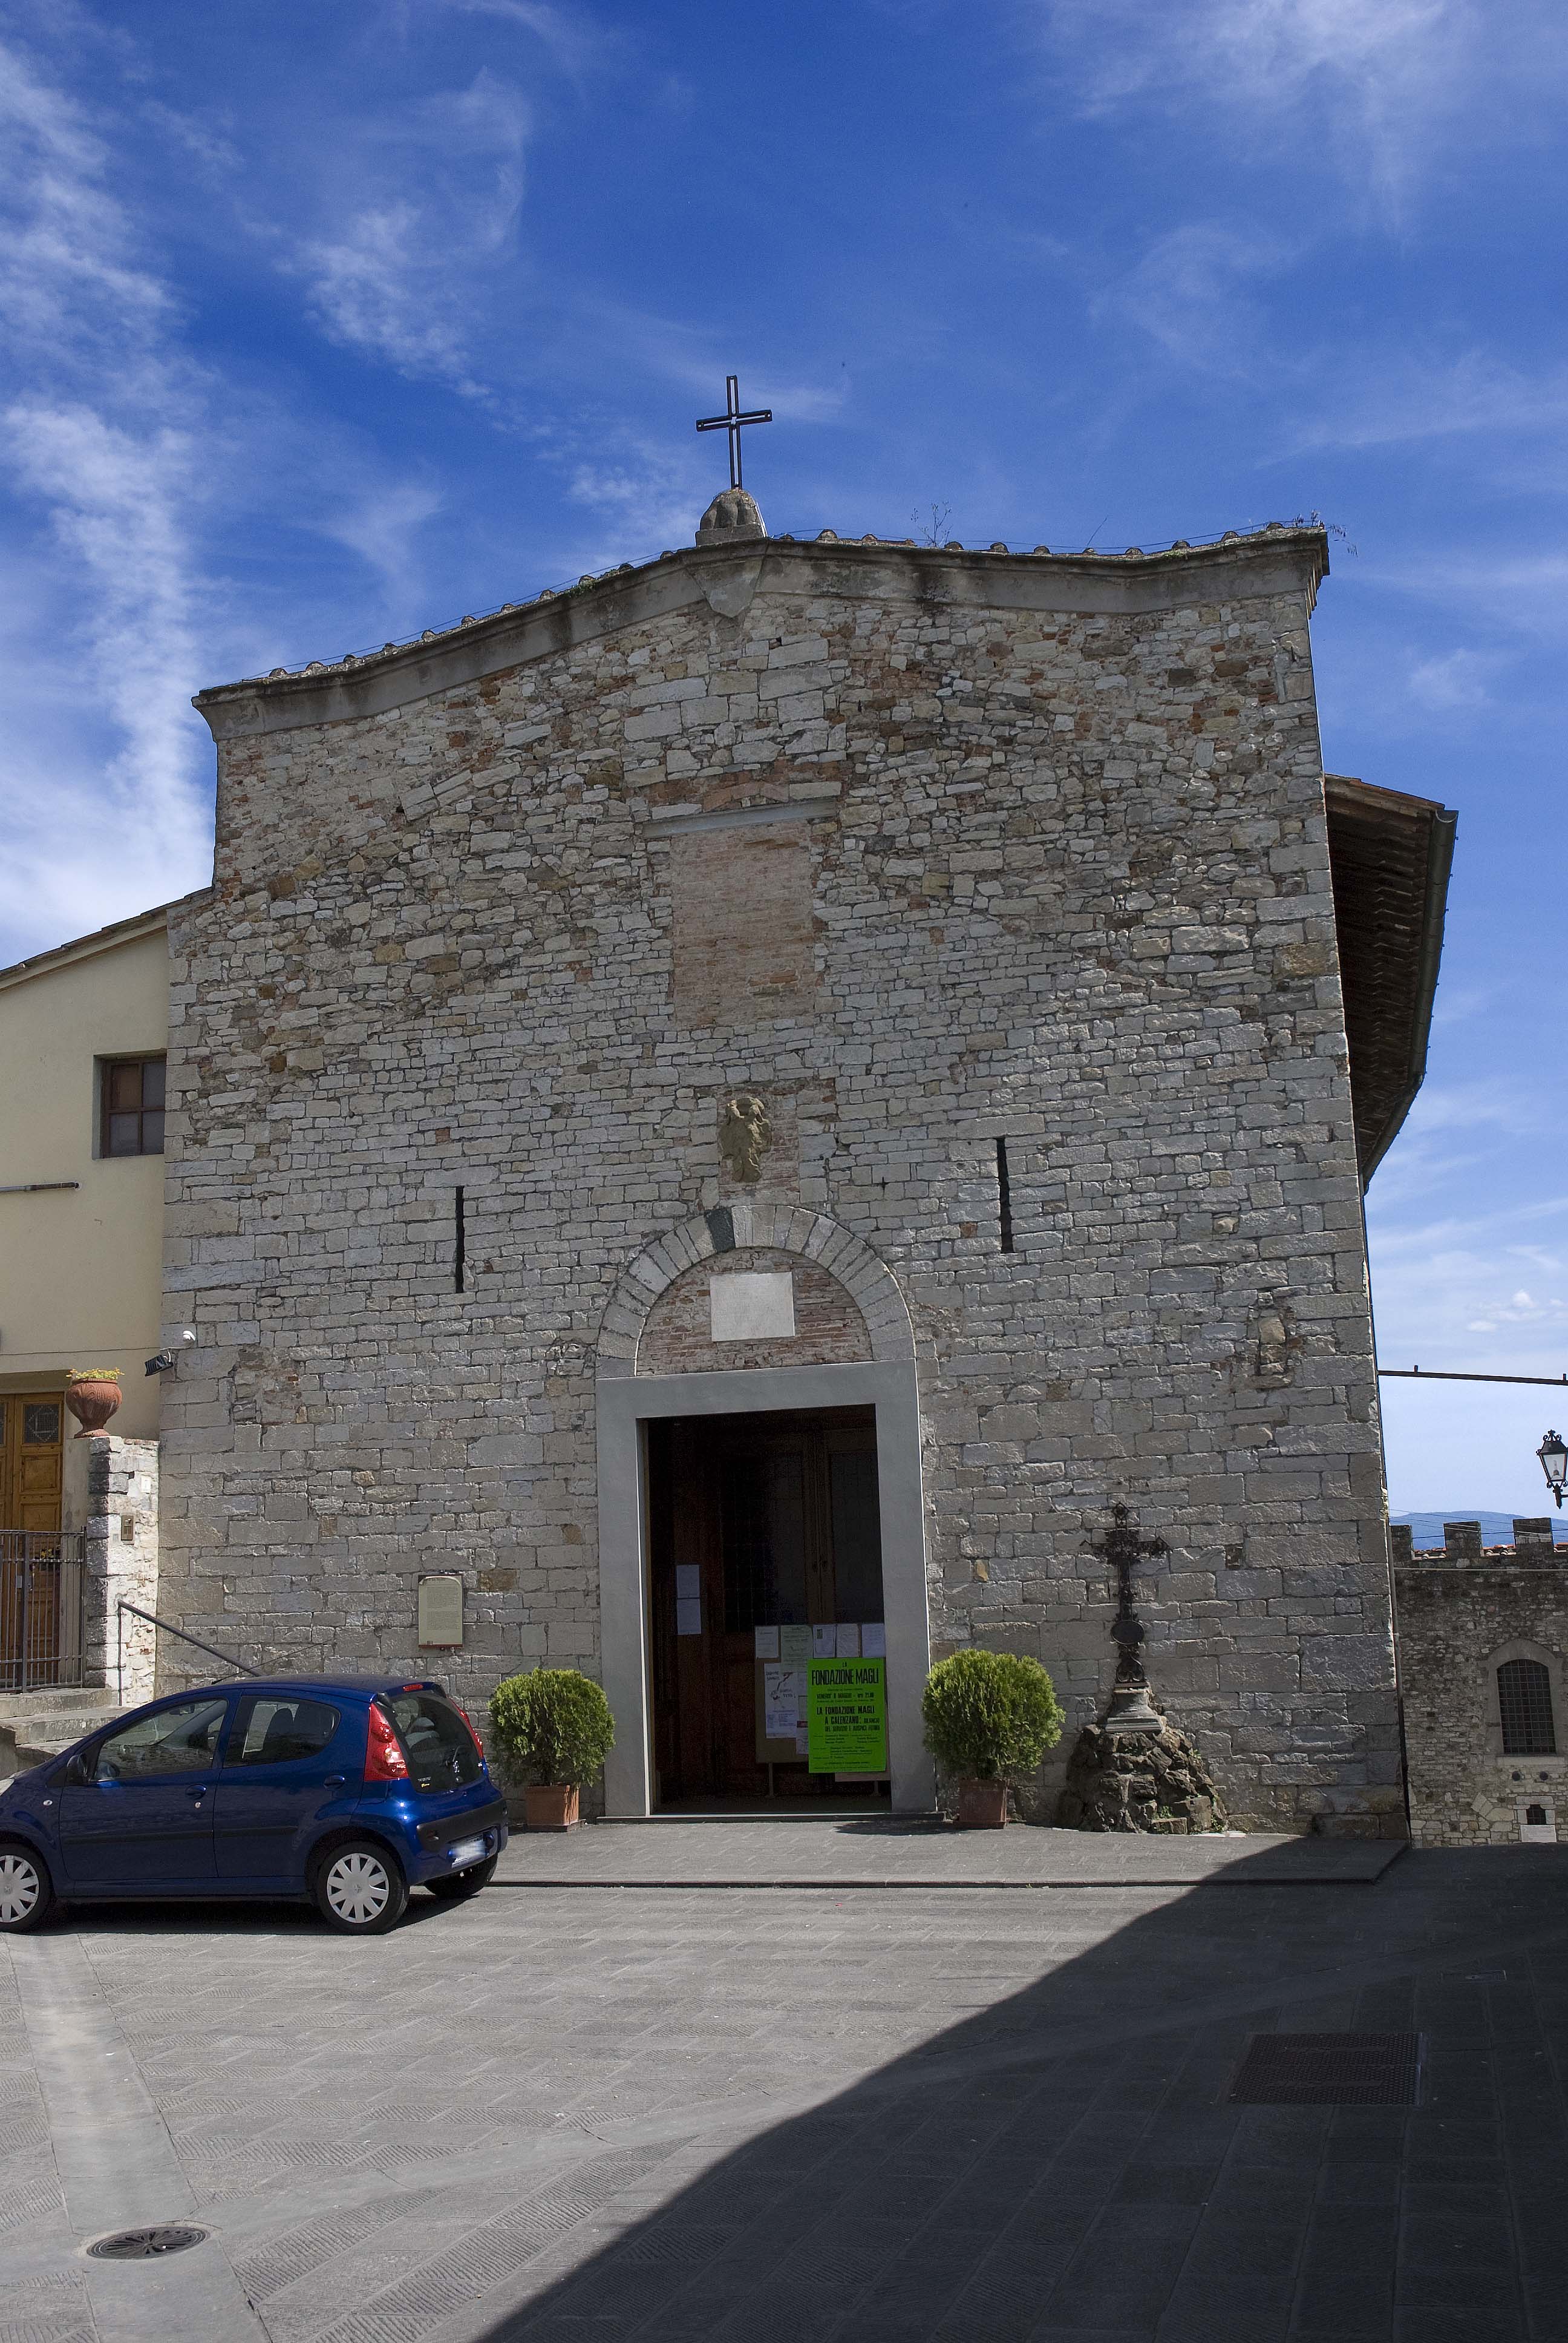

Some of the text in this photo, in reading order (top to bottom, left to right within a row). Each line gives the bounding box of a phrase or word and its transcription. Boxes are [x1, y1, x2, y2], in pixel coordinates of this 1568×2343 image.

[812, 1668, 878, 1685] FONDAZIONE MAGLI
[817, 1705, 875, 1715] LA FONDAZIONE MAGLI
[825, 1716, 828, 1725] A
